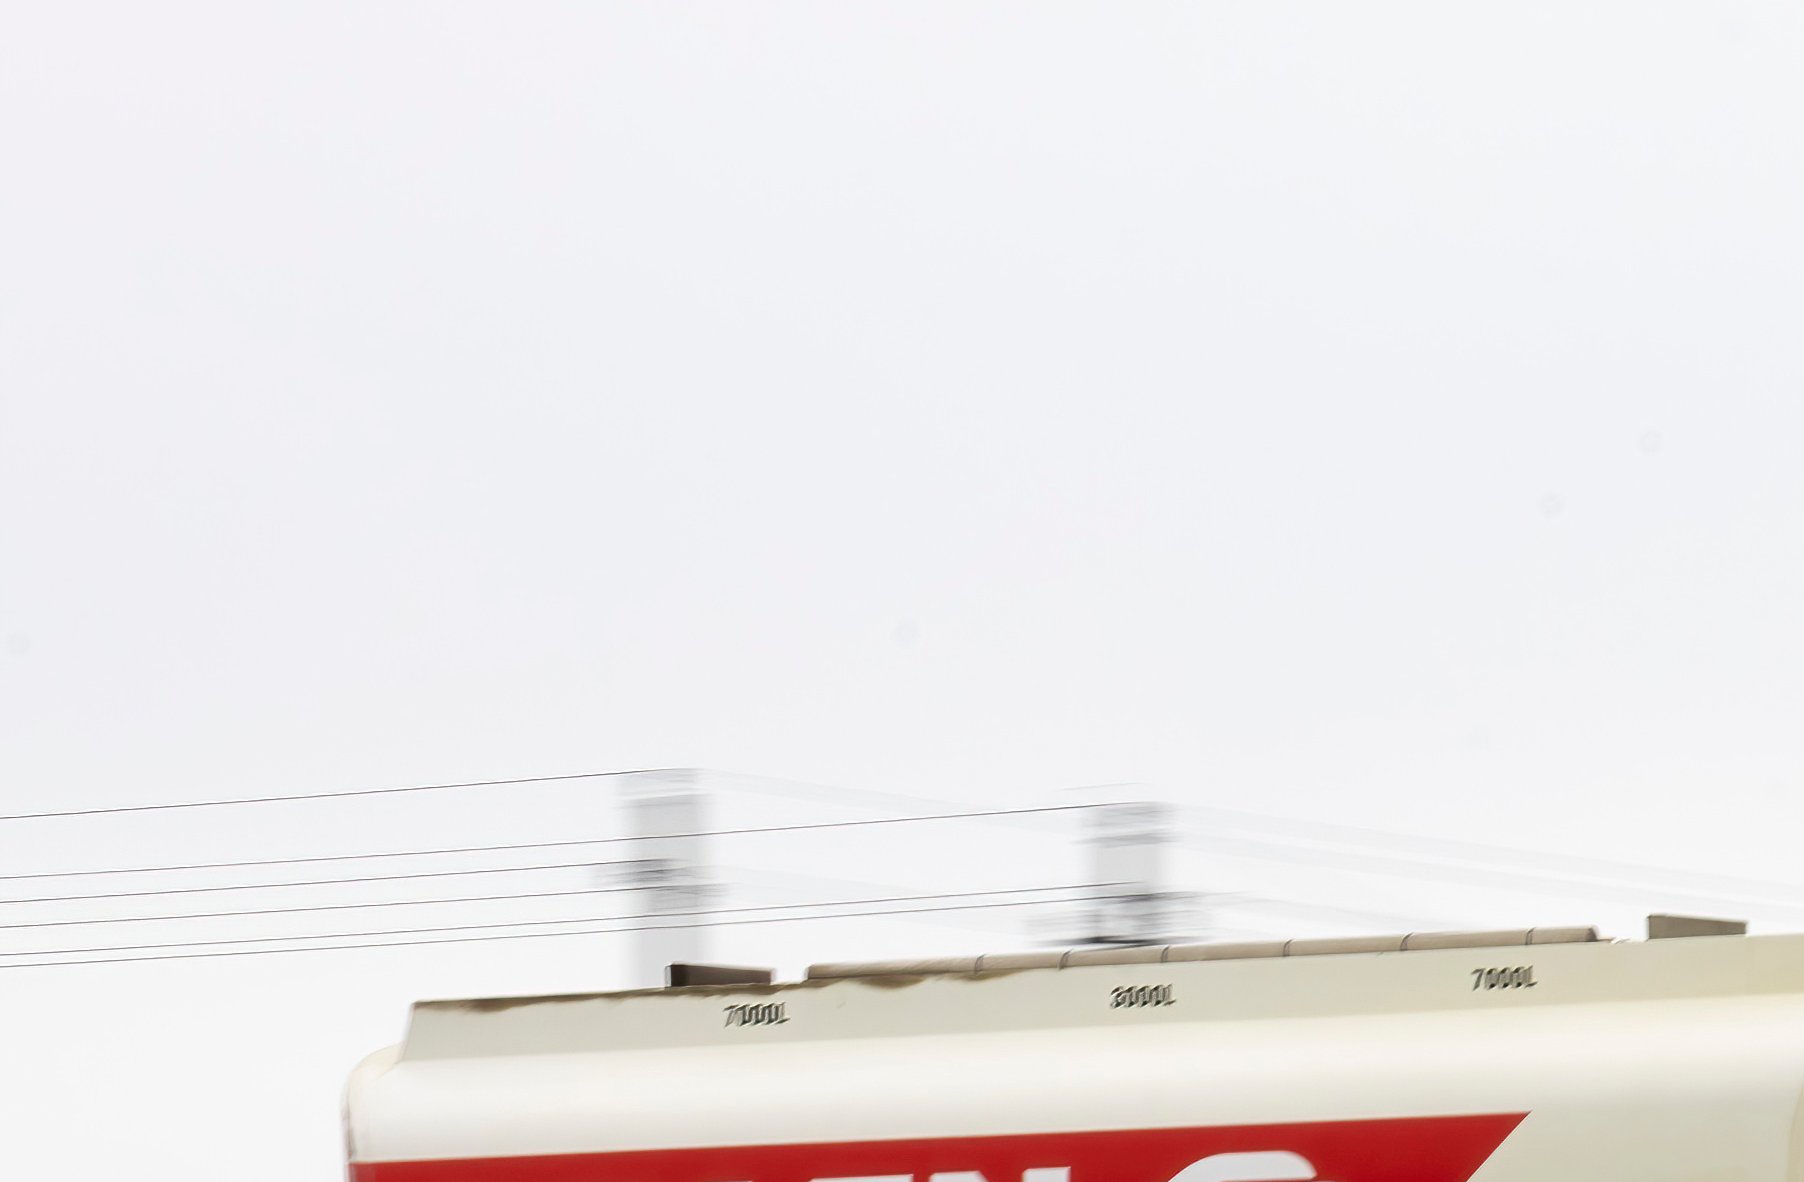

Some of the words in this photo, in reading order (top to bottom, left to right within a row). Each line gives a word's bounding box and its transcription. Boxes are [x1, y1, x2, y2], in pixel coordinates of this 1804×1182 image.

[1471, 965, 1538, 991] 7000L
[1110, 983, 1176, 1008] 3000L
[723, 1002, 790, 1027] 7000L
